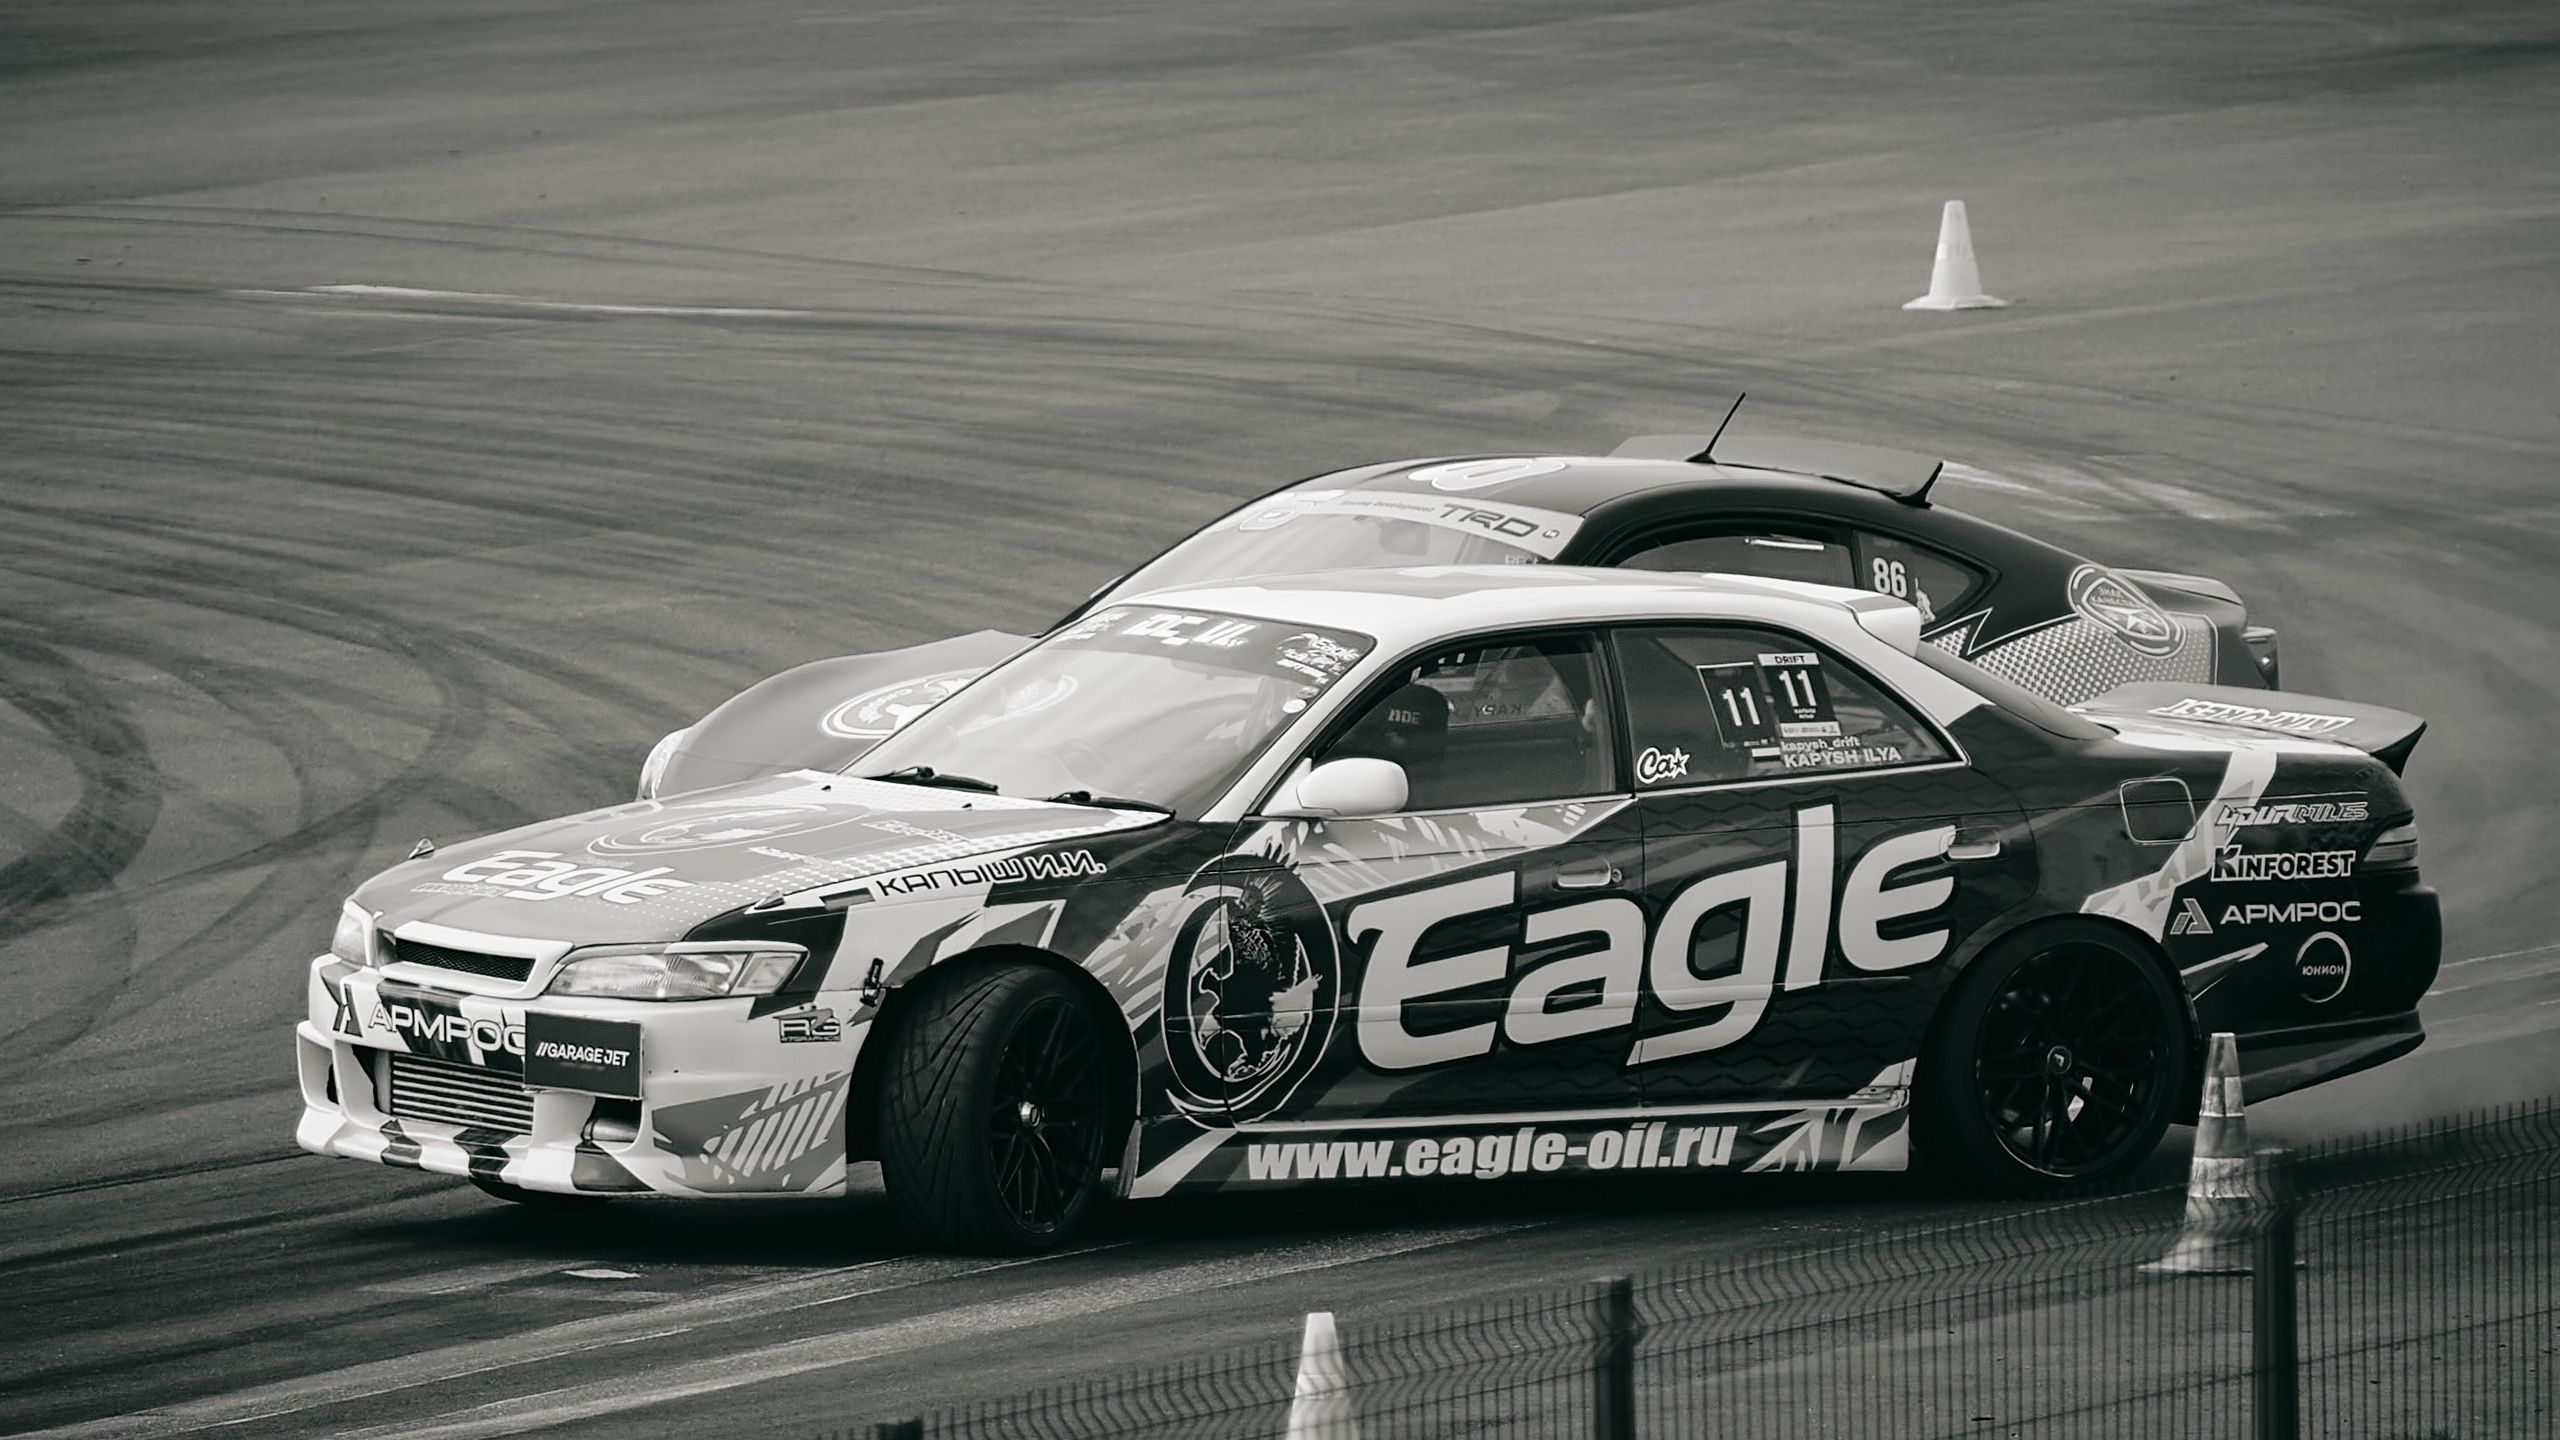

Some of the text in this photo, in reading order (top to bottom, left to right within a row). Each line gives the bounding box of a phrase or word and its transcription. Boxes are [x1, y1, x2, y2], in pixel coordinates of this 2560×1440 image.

[1439, 503, 1541, 538] TRD
[1873, 557, 1907, 598] 86
[1773, 655, 1806, 665] DRIFT
[1722, 687, 1760, 726] 11
[1779, 670, 1817, 707] 11
[1780, 735, 1860, 753] kapysh_drift
[1783, 746, 1901, 768] KAPYSH ILYA
[442, 850, 697, 904] Eagle
[2211, 844, 2356, 882] KINFOREST
[2220, 900, 2362, 925] АРМРОС
[1347, 804, 1957, 1069] Eagle
[2302, 964, 2345, 976] ЮНИОН
[603, 1050, 631, 1067] JET
[1247, 1121, 1739, 1180] www.eagle-oil.ru
